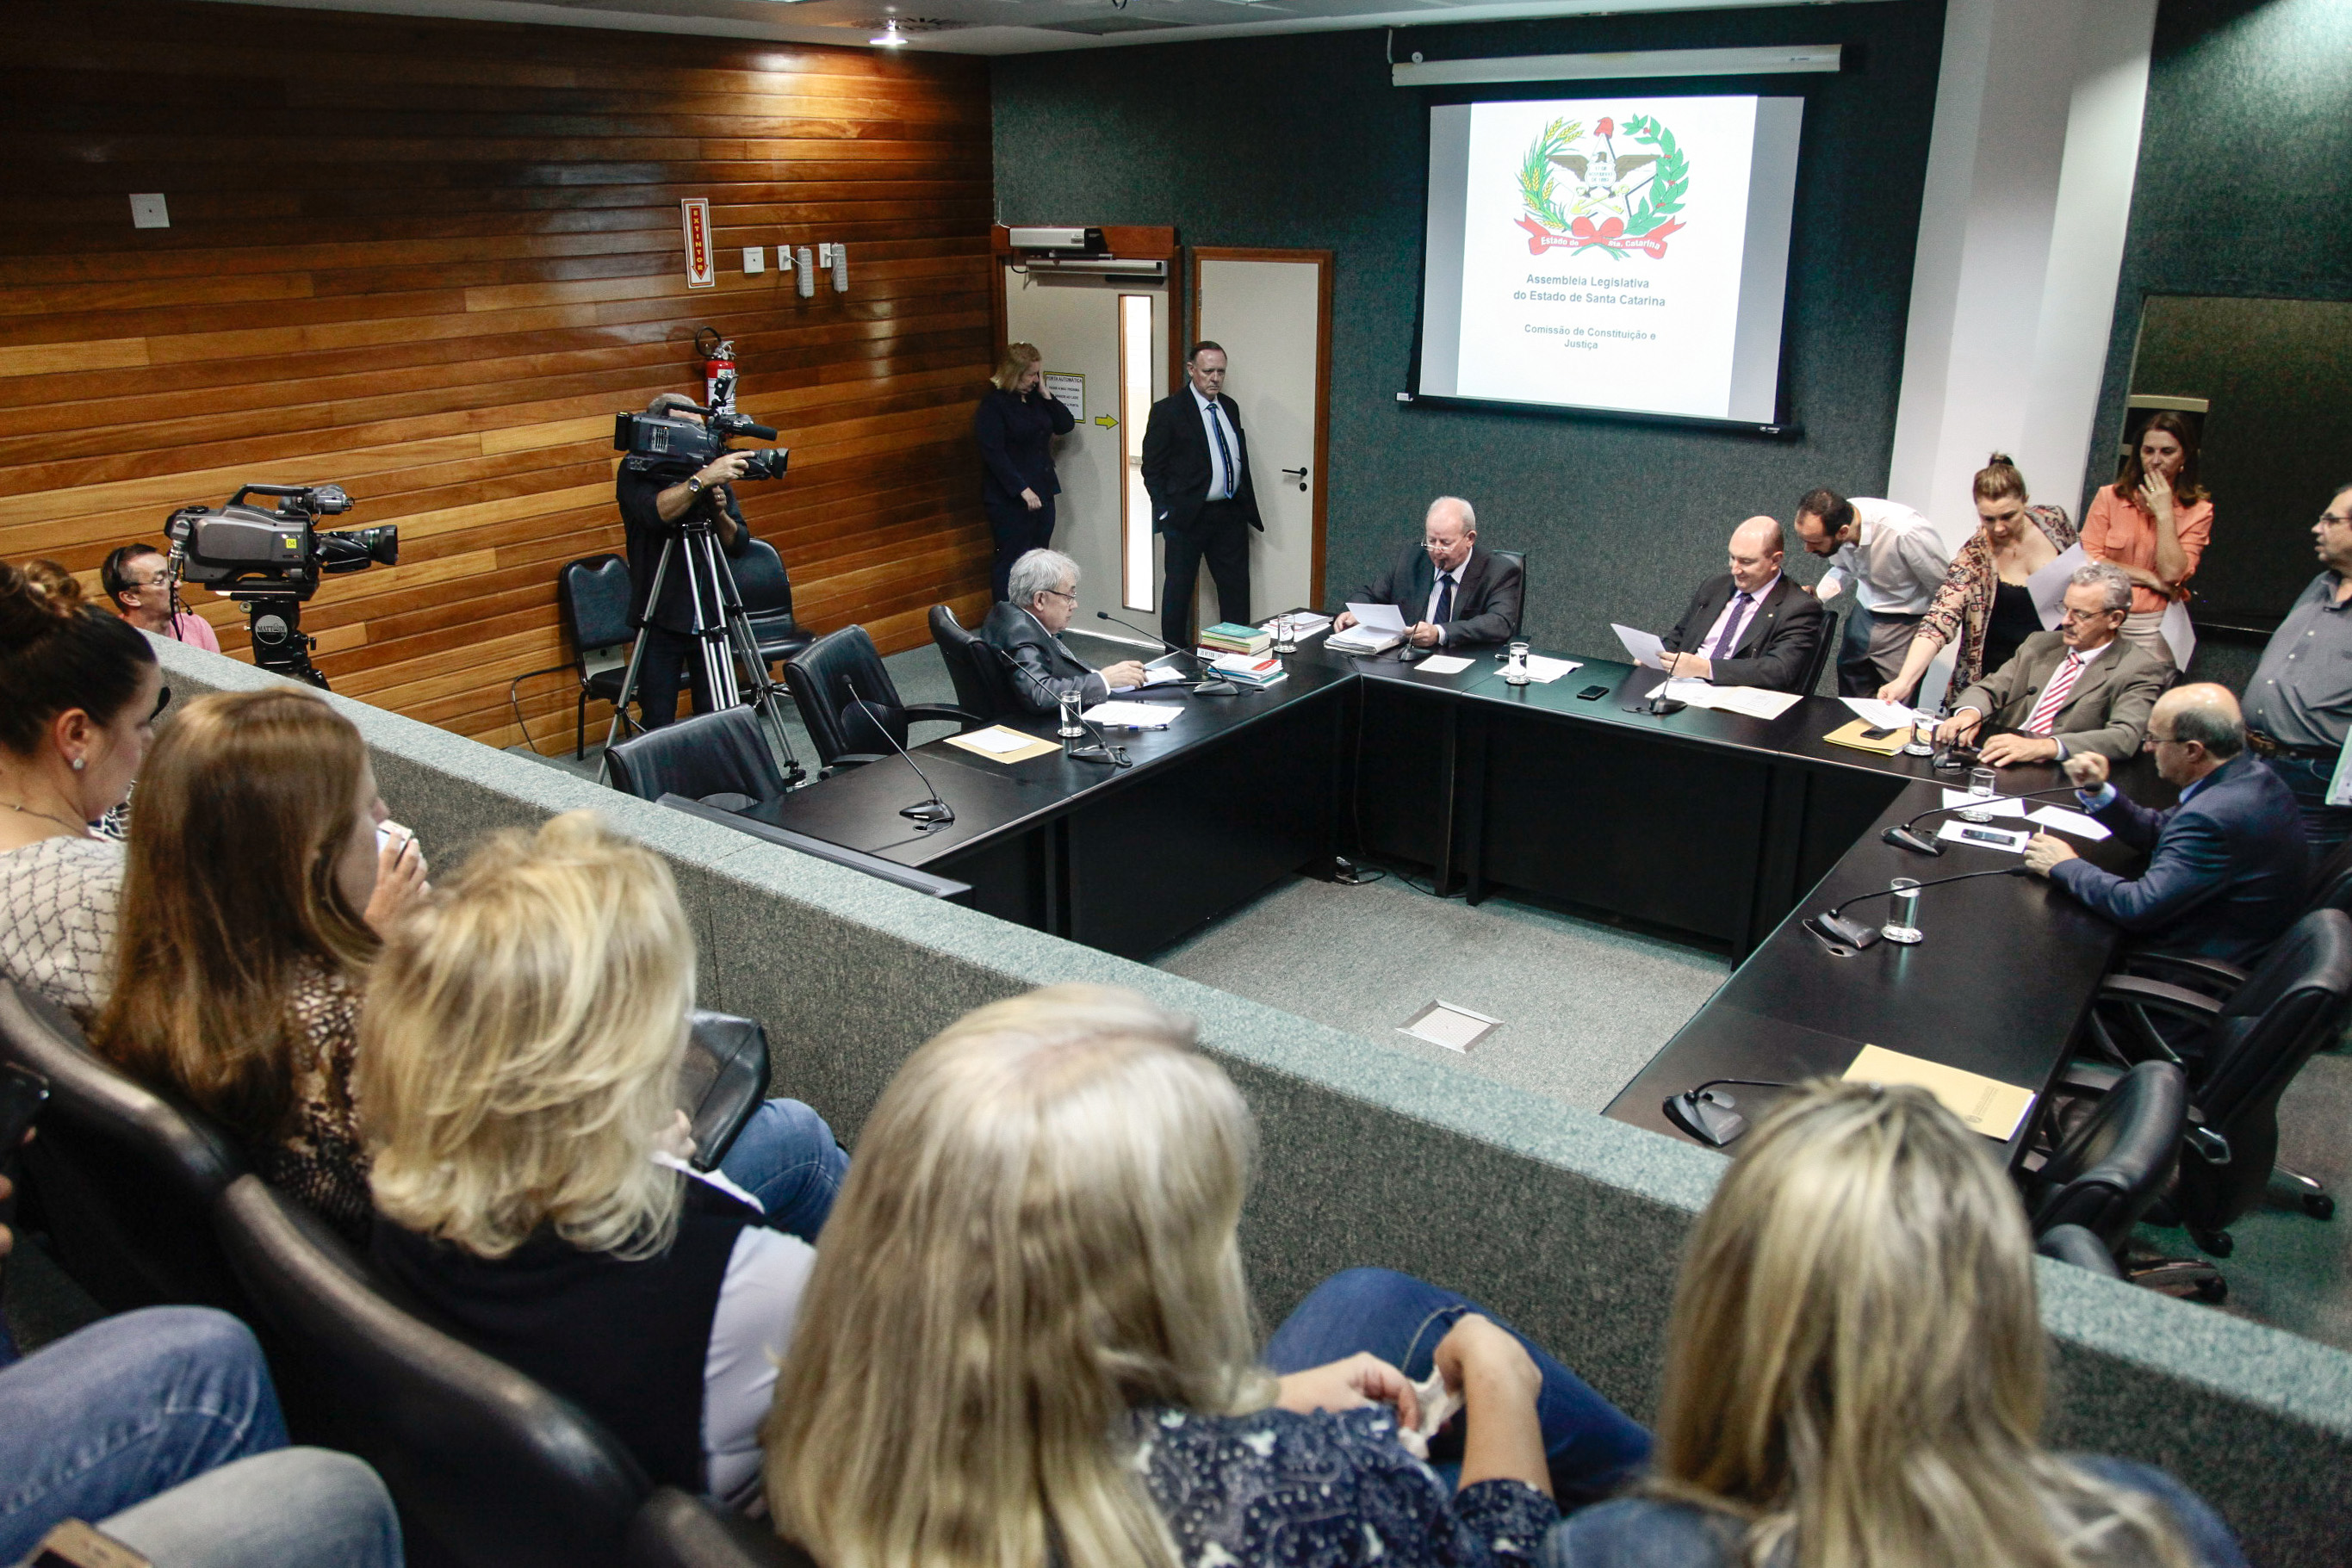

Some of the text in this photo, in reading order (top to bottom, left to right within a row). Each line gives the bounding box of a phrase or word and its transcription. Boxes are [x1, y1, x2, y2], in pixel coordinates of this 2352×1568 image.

[693, 210, 703, 270] EXTINTOR
[1541, 237, 1567, 246] Estado
[1625, 239, 1661, 250] Catarina
[1526, 274, 1650, 289] Assembleia Legislativa
[1513, 290, 1666, 307] do Estado de Santa Catarina
[1524, 324, 1571, 336] Comissão
[1573, 326, 1585, 336] de
[1587, 327, 1648, 341] Constituição
[1564, 339, 1598, 350] Justiça
